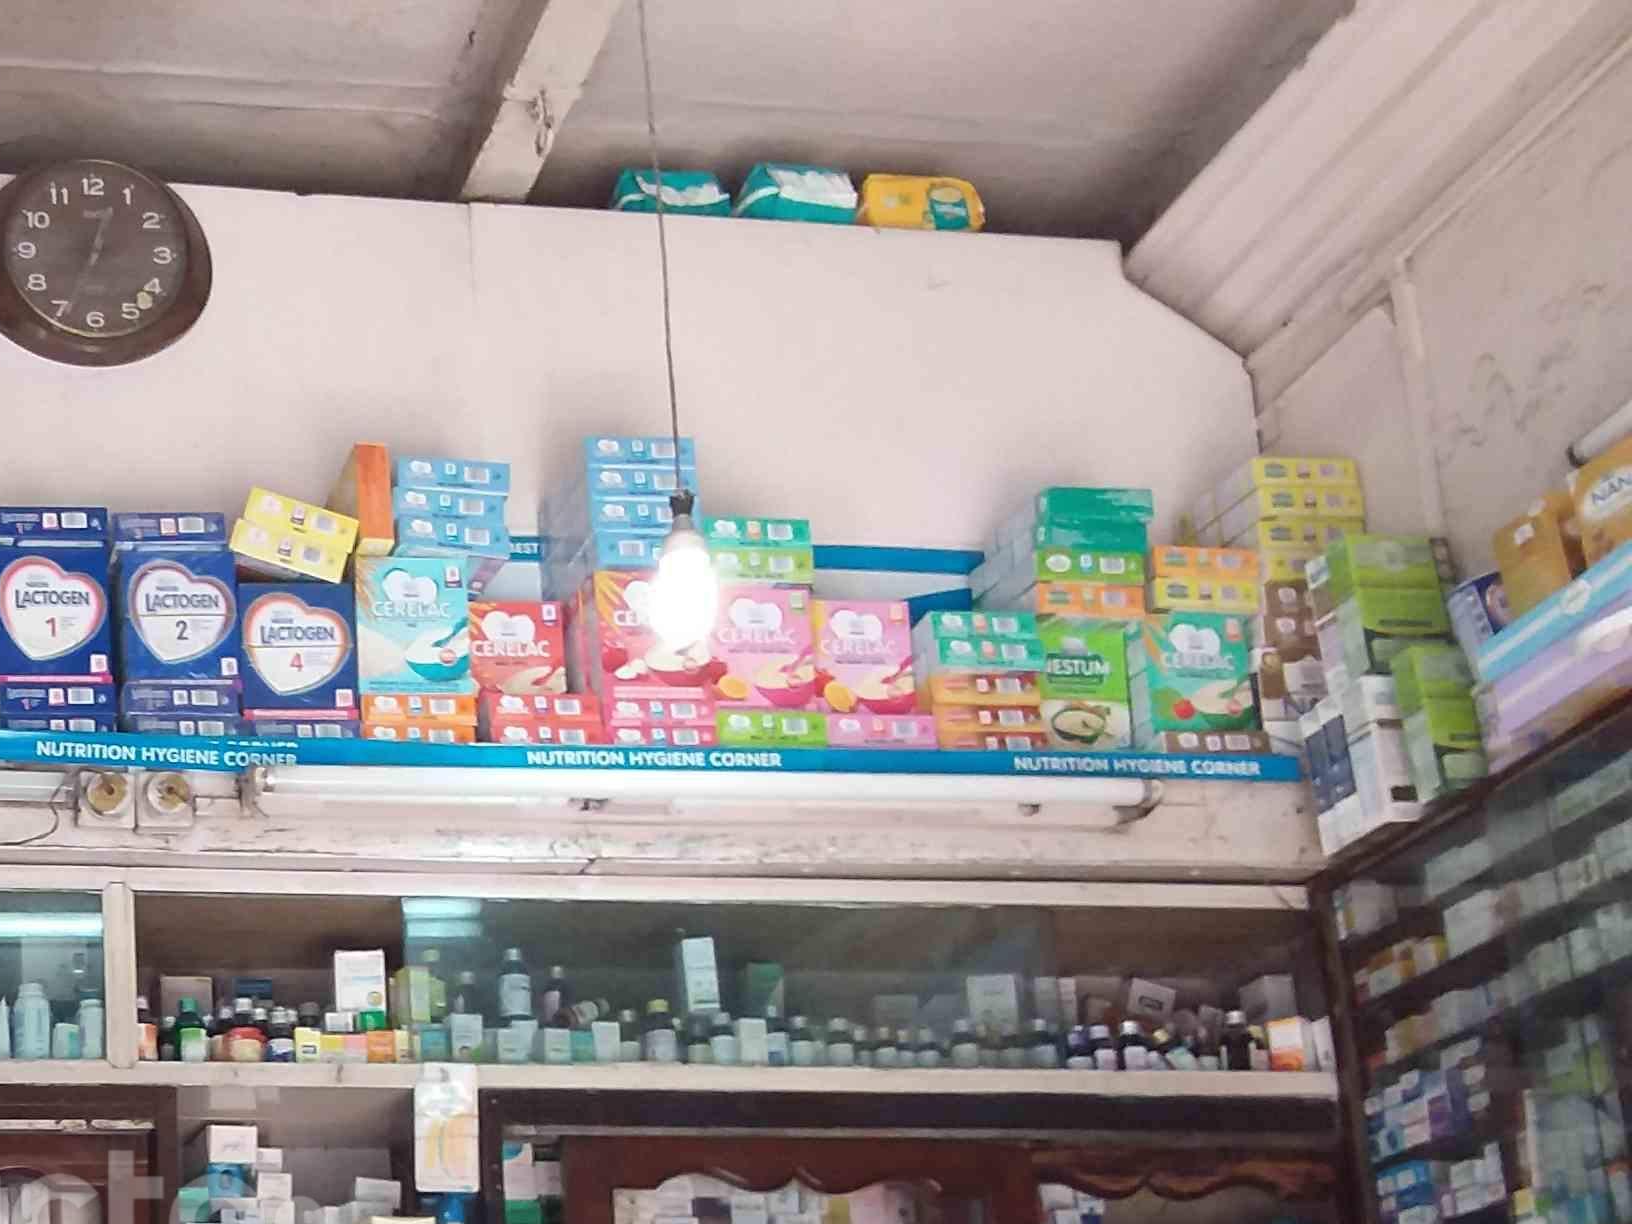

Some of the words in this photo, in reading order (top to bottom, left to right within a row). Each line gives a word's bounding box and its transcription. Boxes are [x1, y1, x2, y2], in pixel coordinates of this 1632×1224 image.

[81, 178, 105, 195] 12
[50, 187, 69, 205] 11
[122, 187, 132, 205] 1
[25, 211, 50, 229] 10
[142, 212, 161, 229] 2
[17, 242, 37, 259] 9
[152, 247, 172, 264] 3
[27, 274, 47, 291] 8
[143, 277, 163, 294] 4
[51, 300, 70, 317] 7
[121, 303, 141, 319] 5
[86, 311, 105, 327] 6
[15, 589, 90, 609] LACTOGEN
[145, 593, 219, 612] LACTOGEN
[45, 617, 56, 637] 1
[176, 620, 189, 640] 2
[260, 625, 335, 645] LACTOGEN
[290, 652, 304, 672] 4
[36, 740, 136, 760] NUTRITION
[141, 749, 219, 766] HYGIENE
[223, 751, 298, 767] CORNER
[526, 750, 625, 766] NUTRITION
[629, 751, 706, 767] HYGIENE
[709, 752, 783, 768] CORNER
[1013, 756, 1108, 772] NUTRITION
[1113, 758, 1188, 774] HYGIENE
[1191, 759, 1261, 776] CORNER
